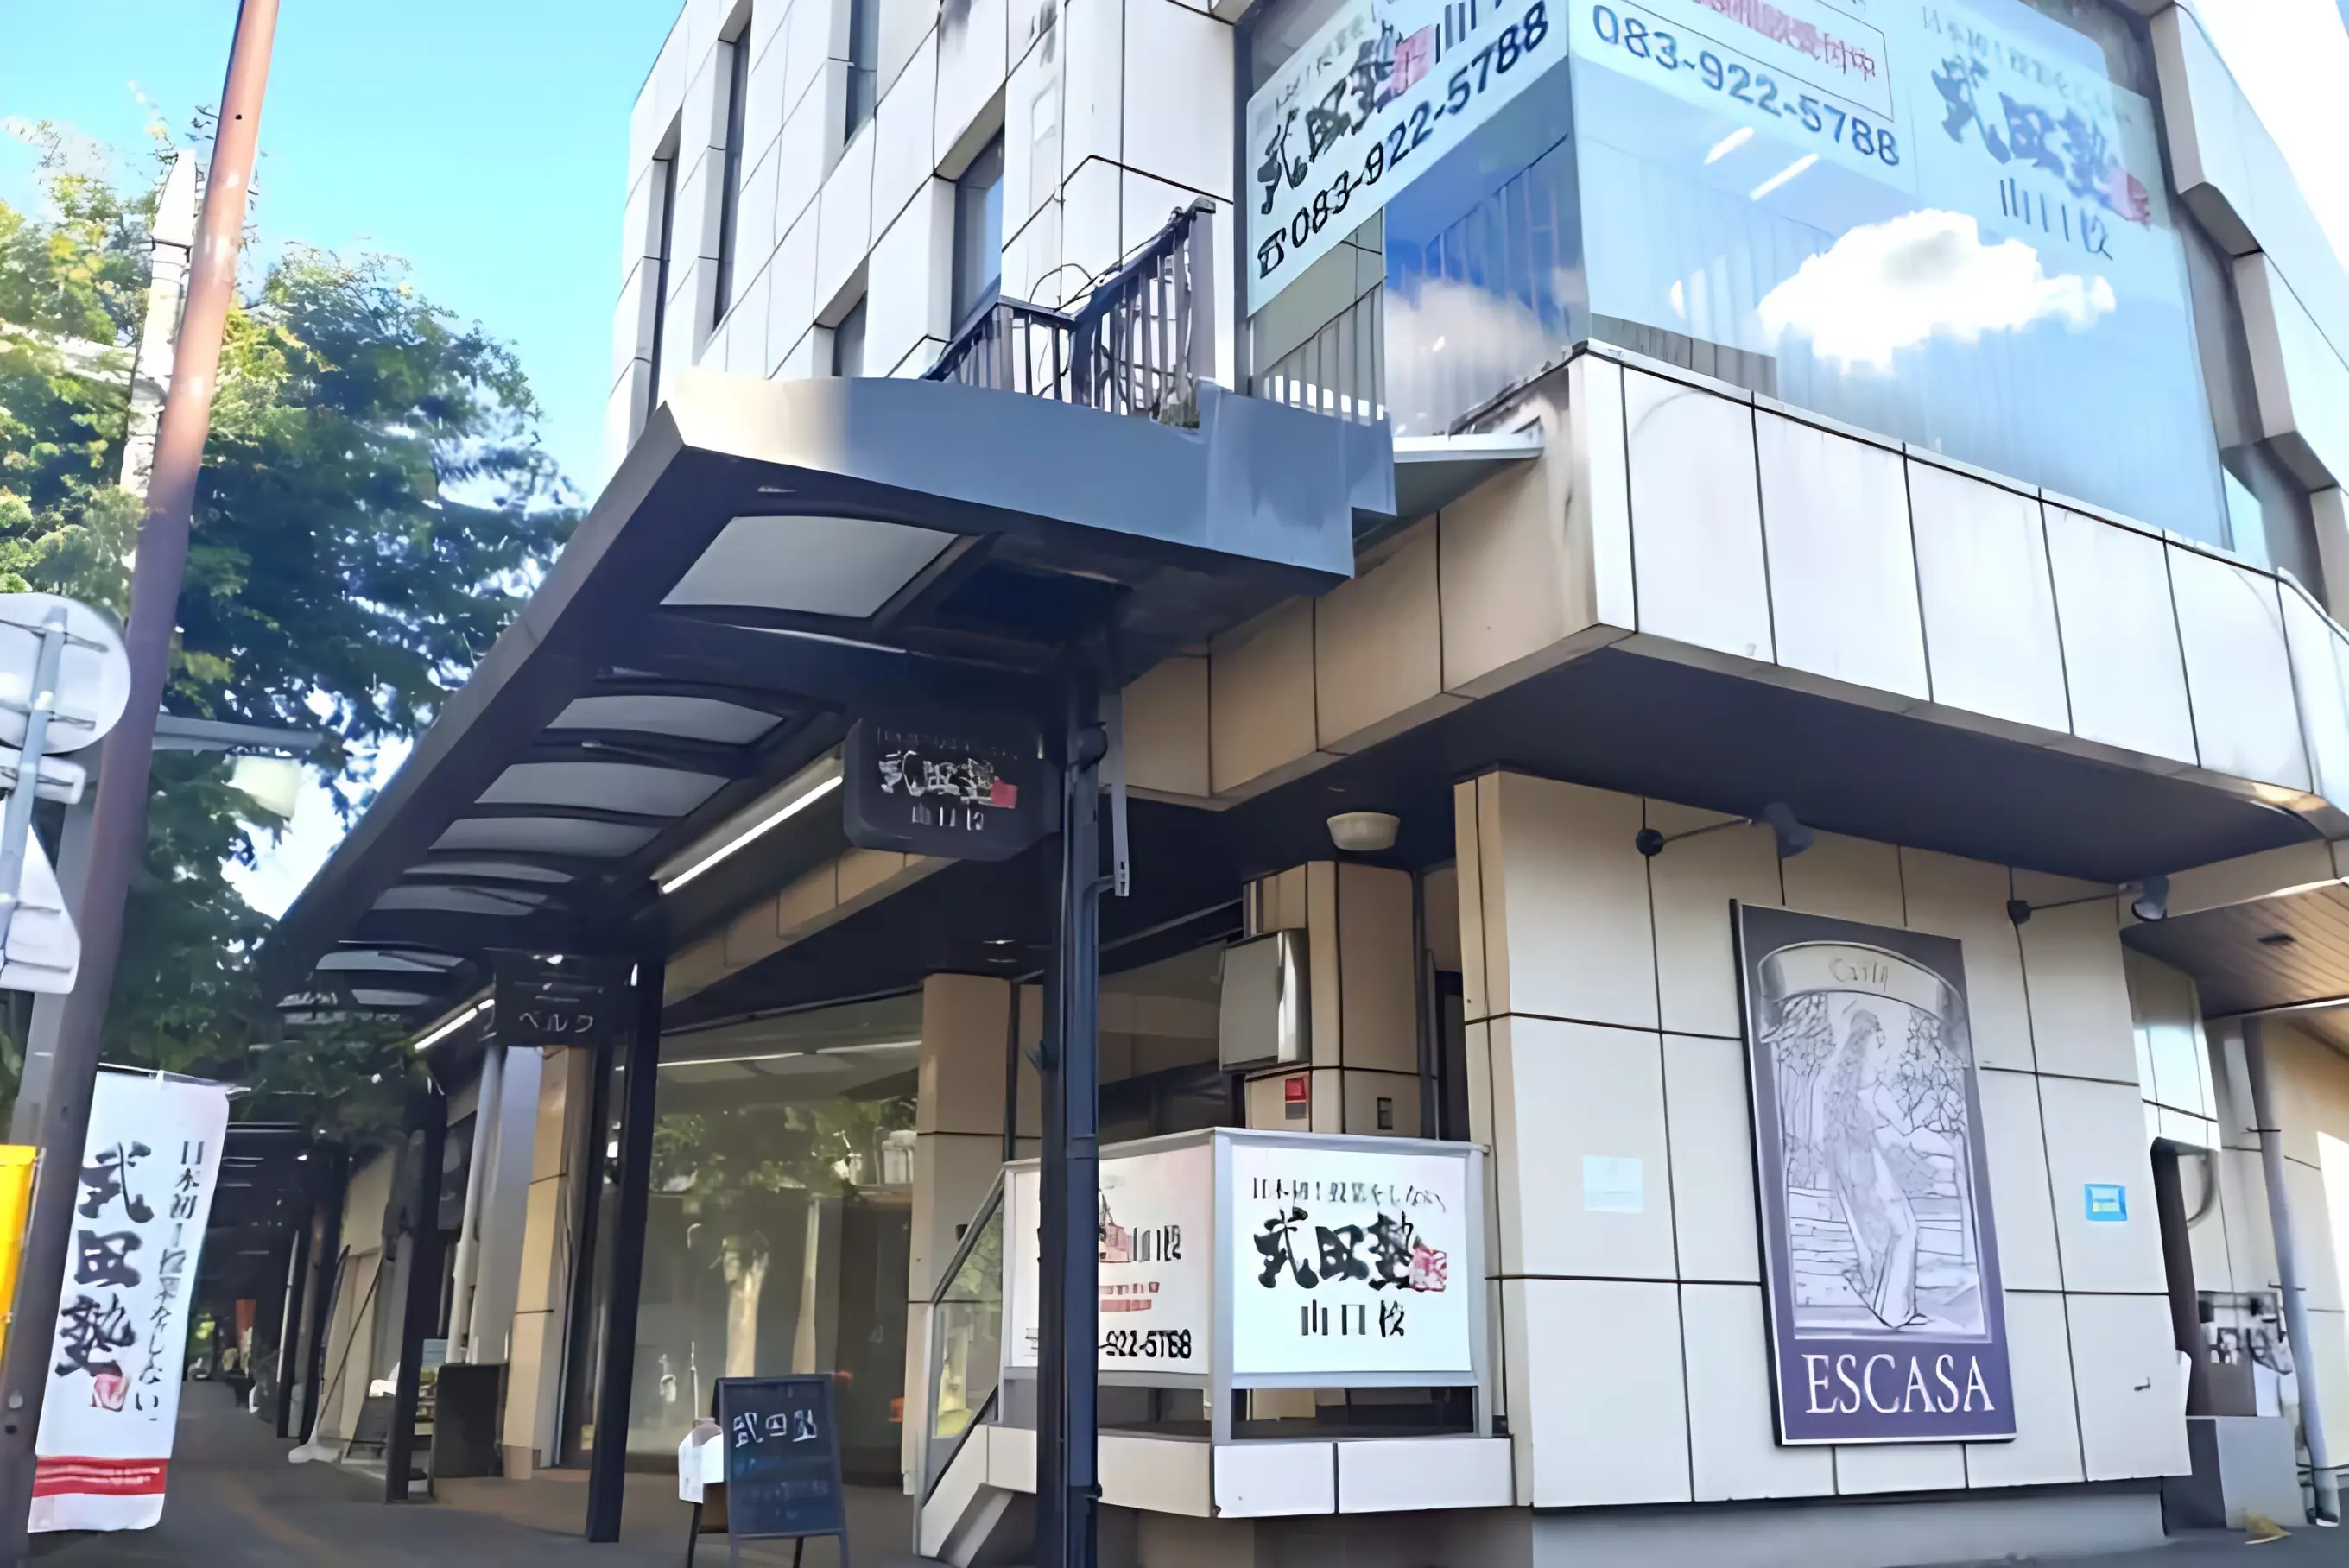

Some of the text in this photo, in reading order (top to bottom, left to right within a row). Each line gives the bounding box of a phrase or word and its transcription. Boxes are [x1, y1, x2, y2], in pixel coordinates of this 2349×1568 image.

[1292, 0, 1548, 249] 083-922-5788
[1593, 4, 1899, 167] 083-922-5788
[1801, 1352, 1997, 1414] ESCASA
